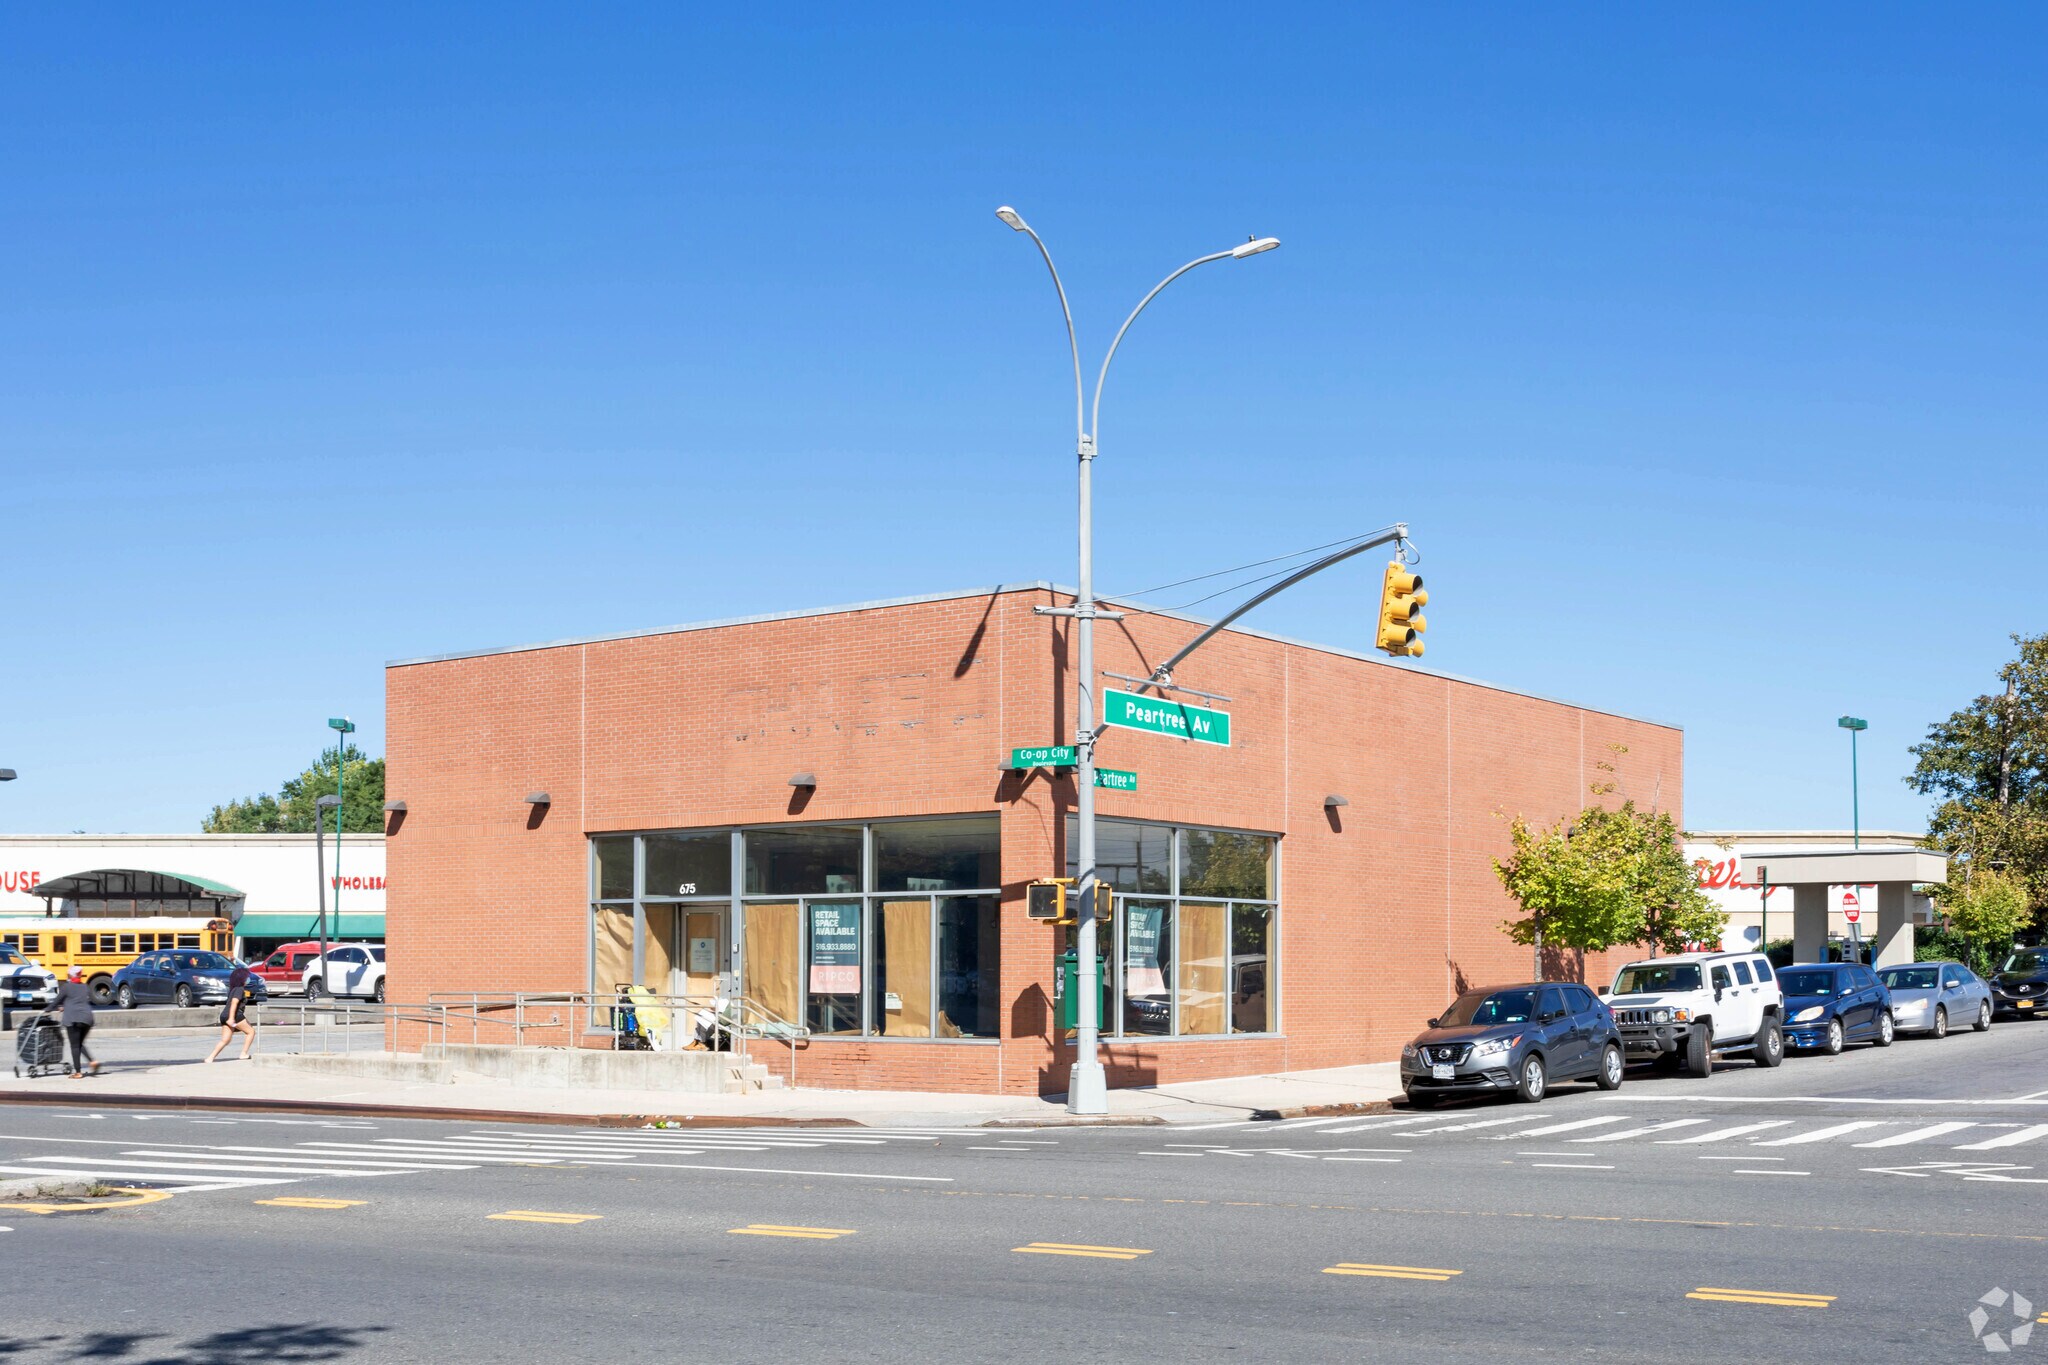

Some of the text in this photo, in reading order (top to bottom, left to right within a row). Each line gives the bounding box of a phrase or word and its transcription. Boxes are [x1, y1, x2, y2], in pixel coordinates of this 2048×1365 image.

[1126, 702, 1210, 733] Peartree Av
[1020, 748, 1069, 760] Co-op City
[0, 870, 40, 892] USE
[679, 883, 696, 894] 675
[815, 911, 840, 919] RETAIL
[815, 919, 839, 927] SPACE
[815, 927, 856, 936] AVAILABLE
[819, 971, 855, 982] RIPCO
